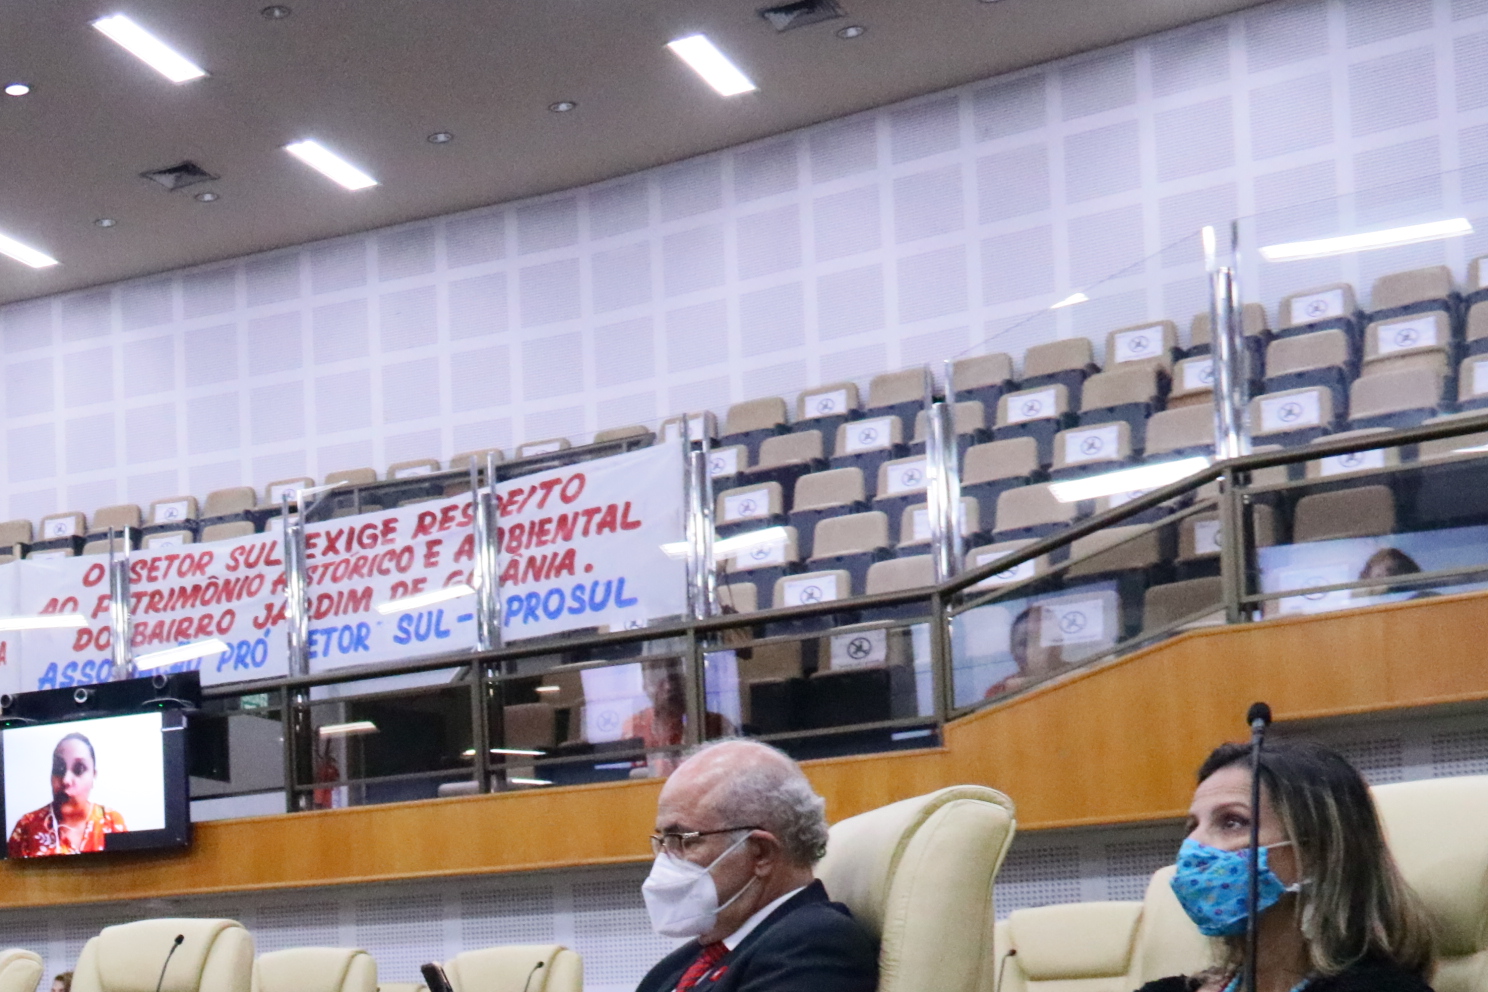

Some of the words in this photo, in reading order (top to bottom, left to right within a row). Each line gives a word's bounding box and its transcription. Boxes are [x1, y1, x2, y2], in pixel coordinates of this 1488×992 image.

[82, 563, 105, 588] O
[130, 551, 214, 585] SETOR
[225, 540, 283, 572] SUL
[305, 518, 399, 560] EXIGE
[91, 573, 265, 620] PTRIMÔNIO
[423, 538, 443, 568] E
[72, 625, 111, 652] DO
[130, 608, 236, 648] BAIRRO
[216, 627, 271, 673] PRÓ
[307, 622, 371, 660] ETOR
[503, 576, 639, 628] PROSUL
